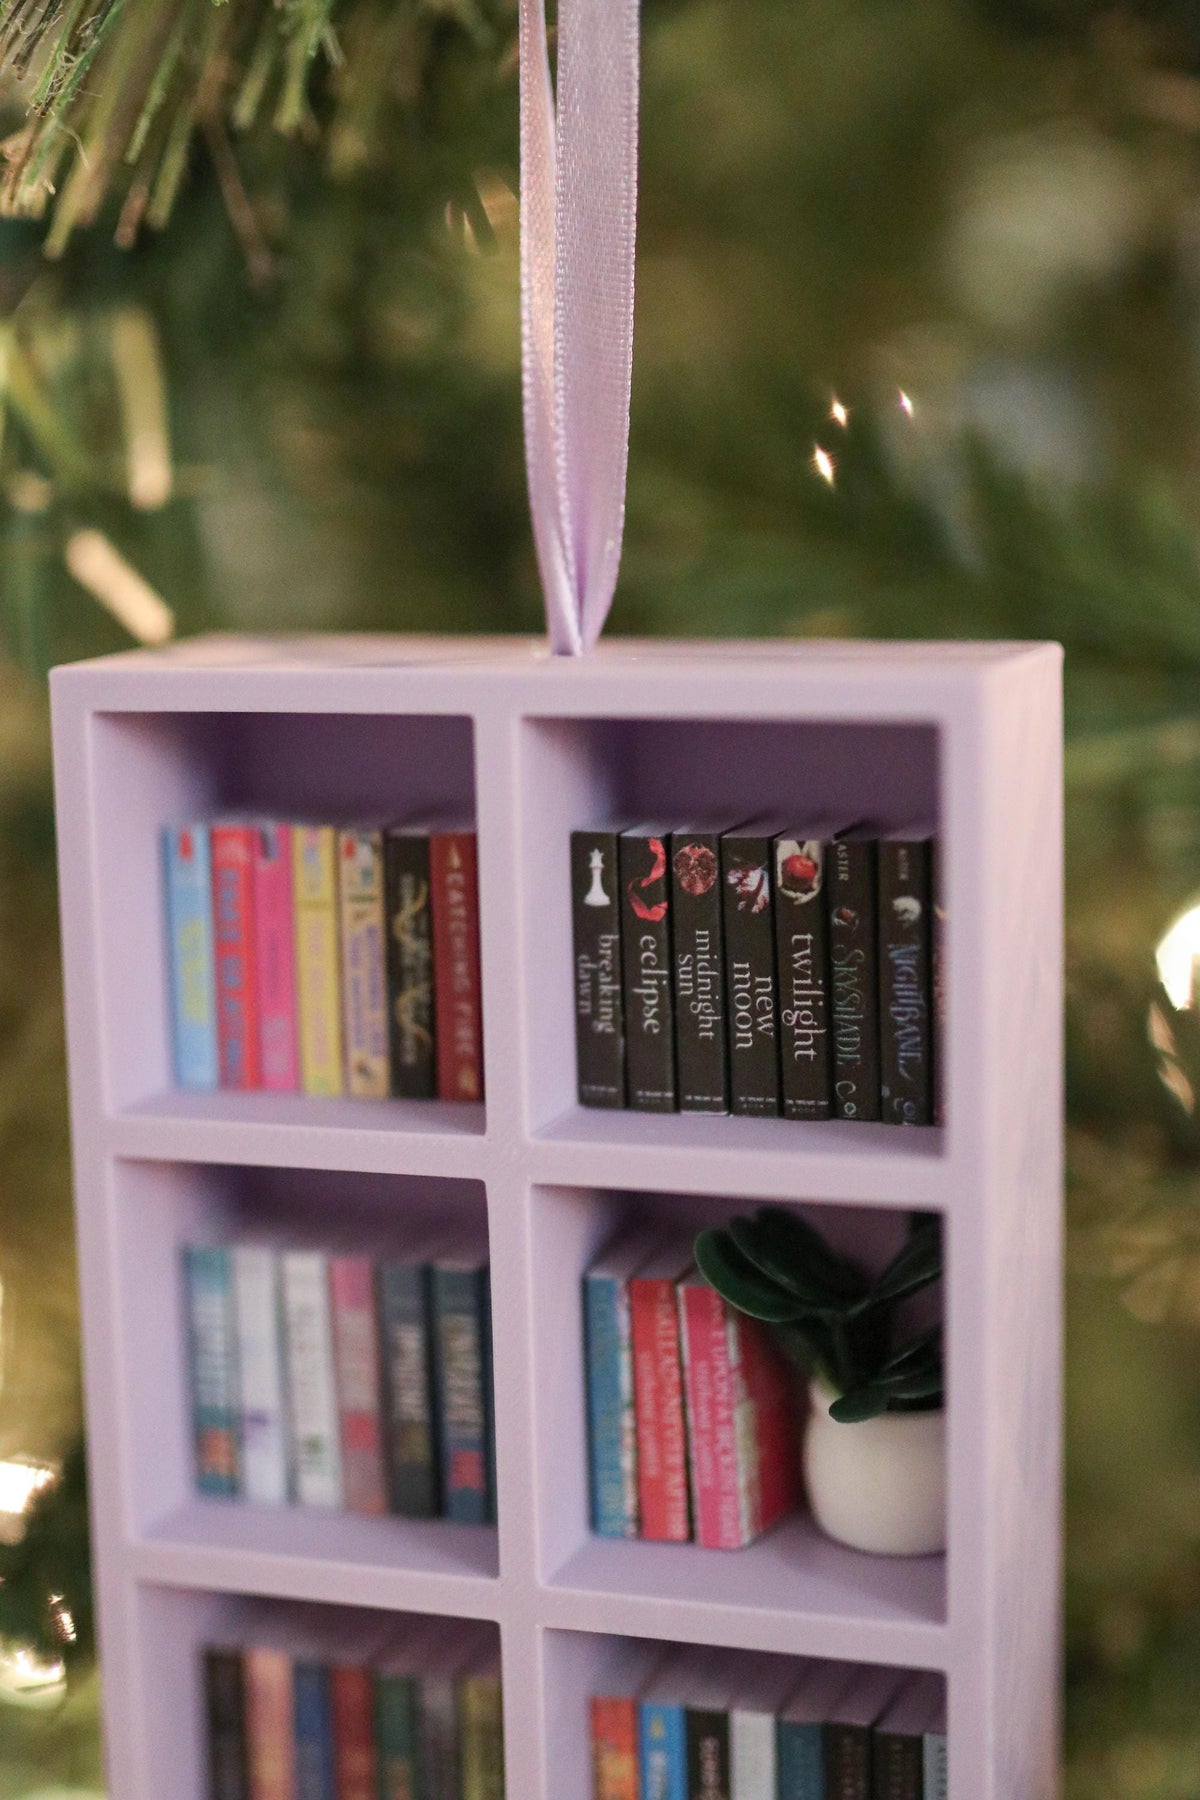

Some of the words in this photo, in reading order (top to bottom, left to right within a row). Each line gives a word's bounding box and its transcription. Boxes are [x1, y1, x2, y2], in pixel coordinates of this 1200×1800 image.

[836, 843, 850, 882] ASTER
[577, 954, 600, 1014] dawn
[594, 933, 620, 1035] breaking
[632, 934, 668, 1035] eclipse
[677, 953, 697, 996] sun
[689, 928, 720, 1040] midnight
[732, 961, 756, 1050] moon
[754, 975, 776, 1038] new
[781, 932, 829, 1062] twilight
[830, 944, 866, 1066] SKYSHADE
[886, 943, 926, 1080] NIGHTBANE
